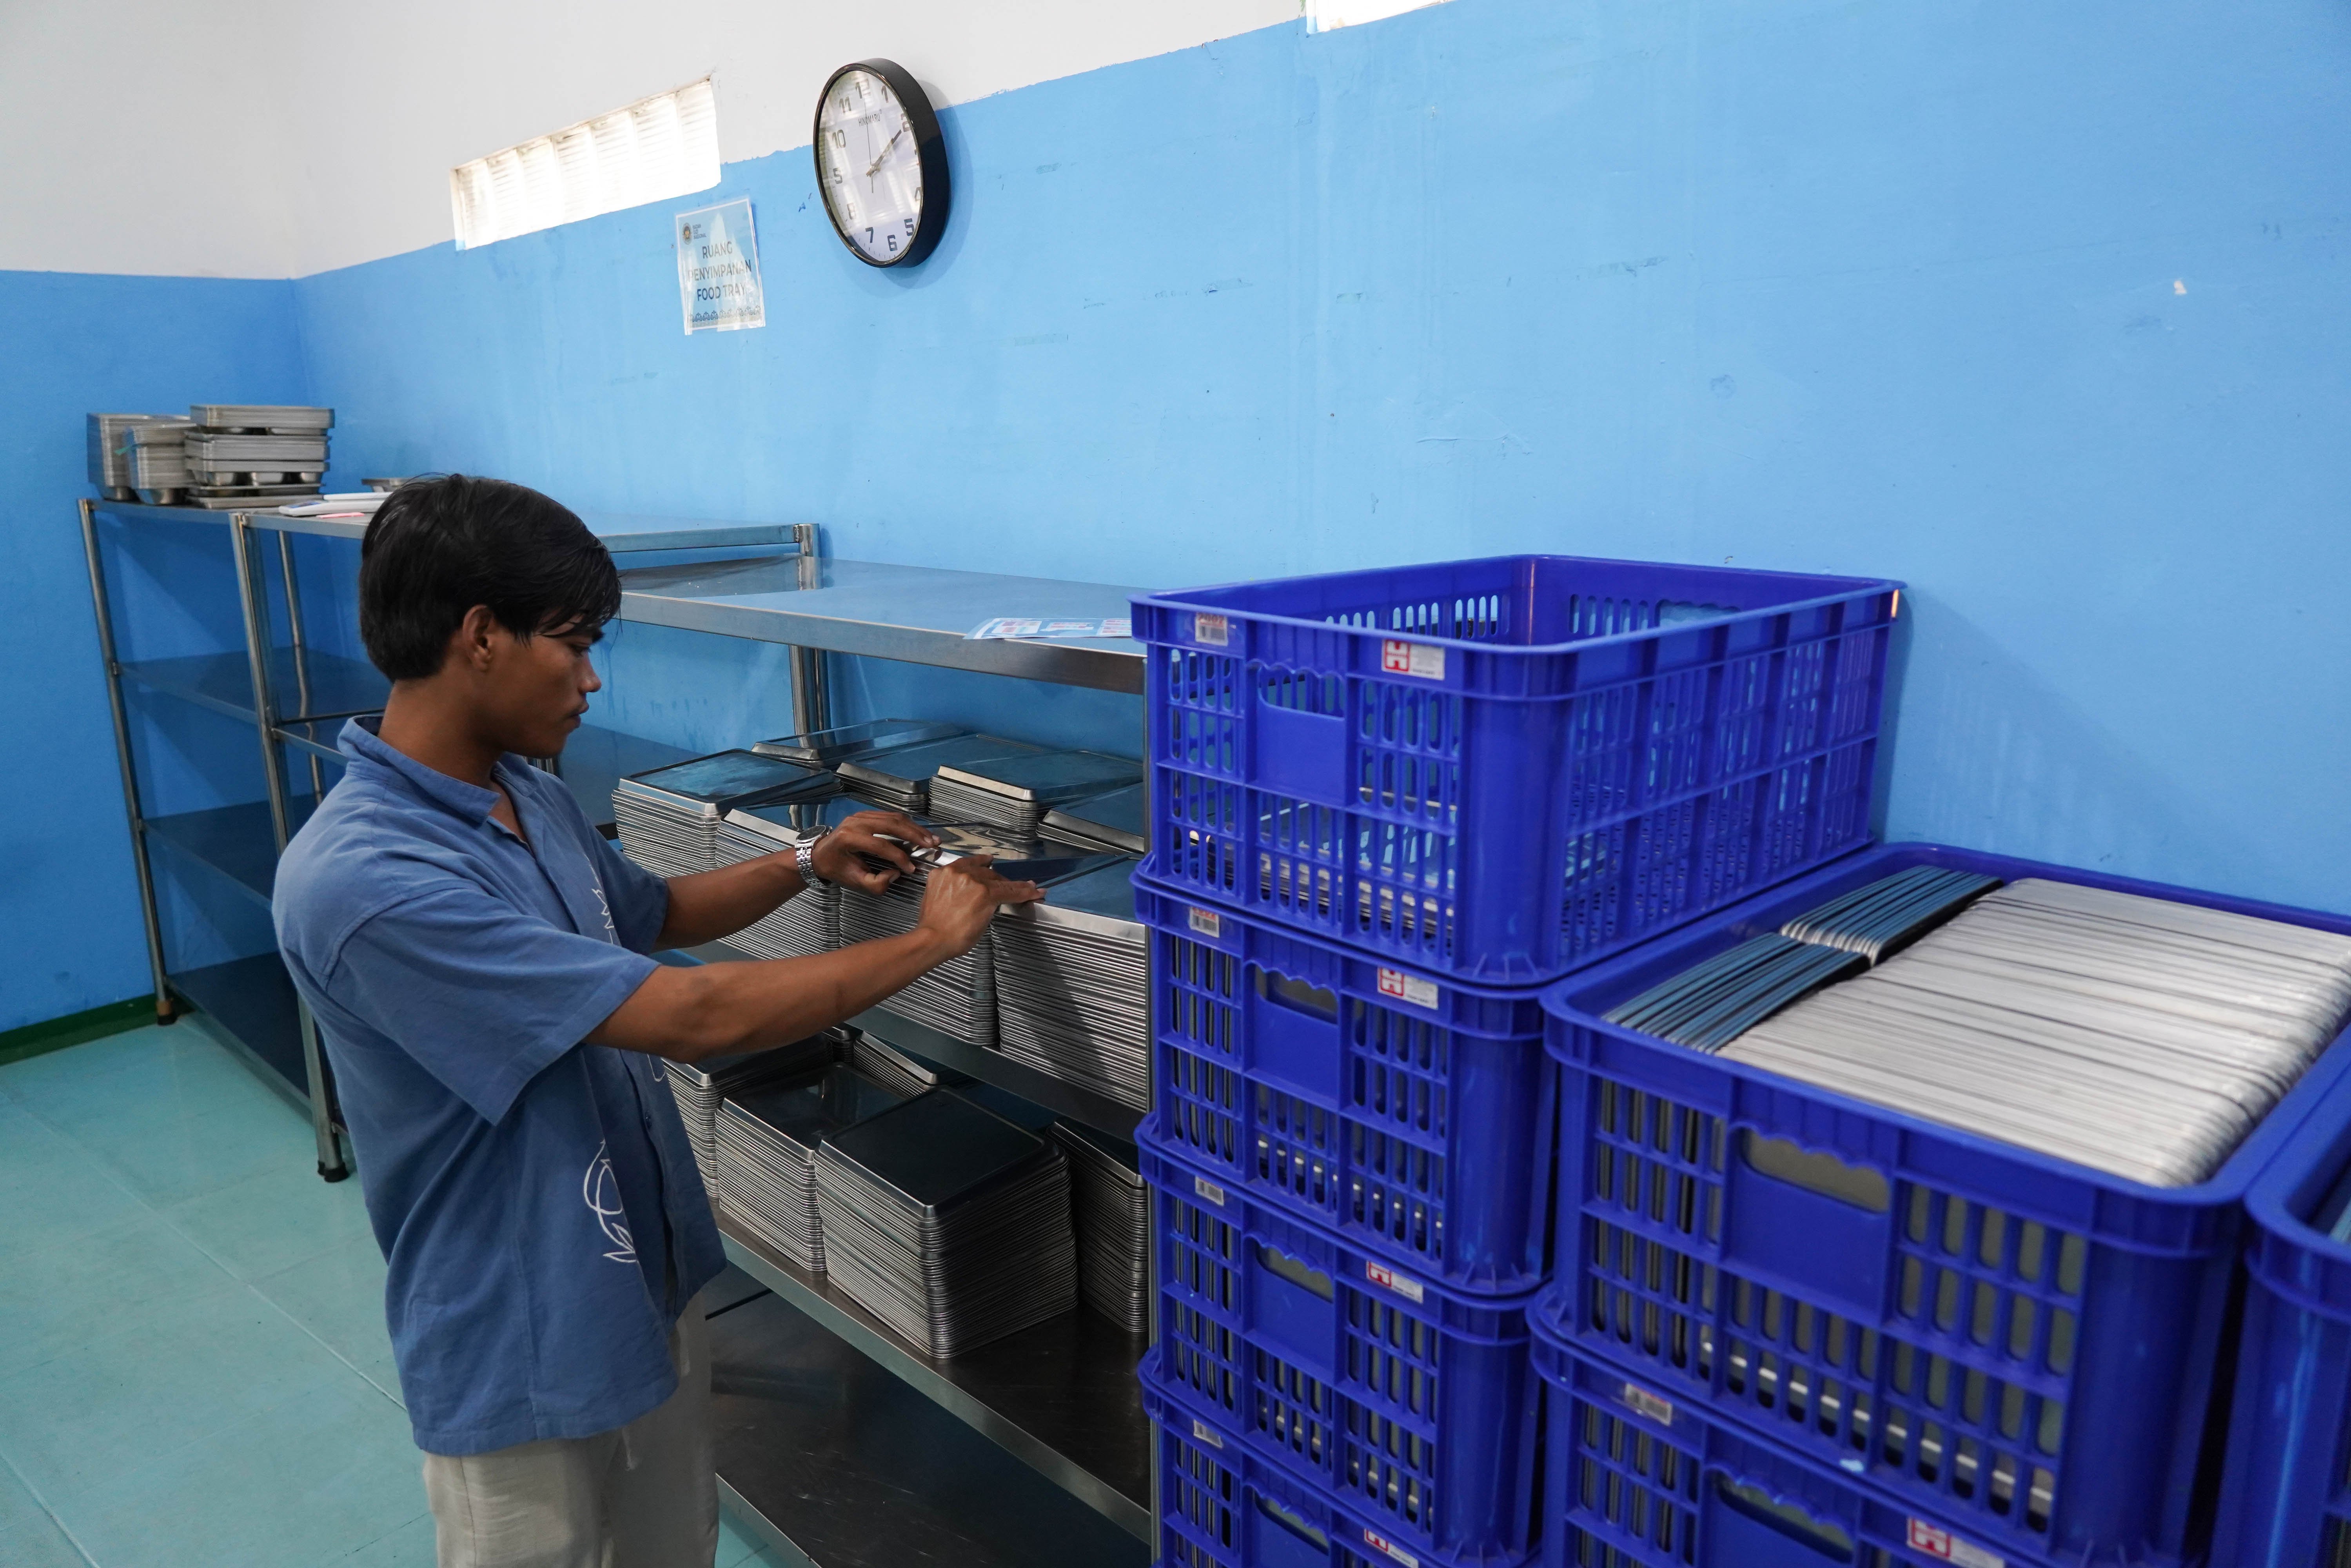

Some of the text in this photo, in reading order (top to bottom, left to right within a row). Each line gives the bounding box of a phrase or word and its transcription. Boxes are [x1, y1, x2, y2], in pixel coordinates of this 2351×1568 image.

[881, 85, 888, 103] 1
[839, 96, 851, 113] 11
[858, 113, 880, 126] HINOMARU
[832, 129, 846, 149] 10
[847, 203, 856, 220] 8
[865, 227, 873, 243] 7
[904, 218, 914, 236] 5
[702, 241, 732, 259] RUANG
[888, 234, 897, 251] 6
[688, 259, 752, 282] PENYIMPANAN
[697, 282, 746, 301] FOOD TRAY
